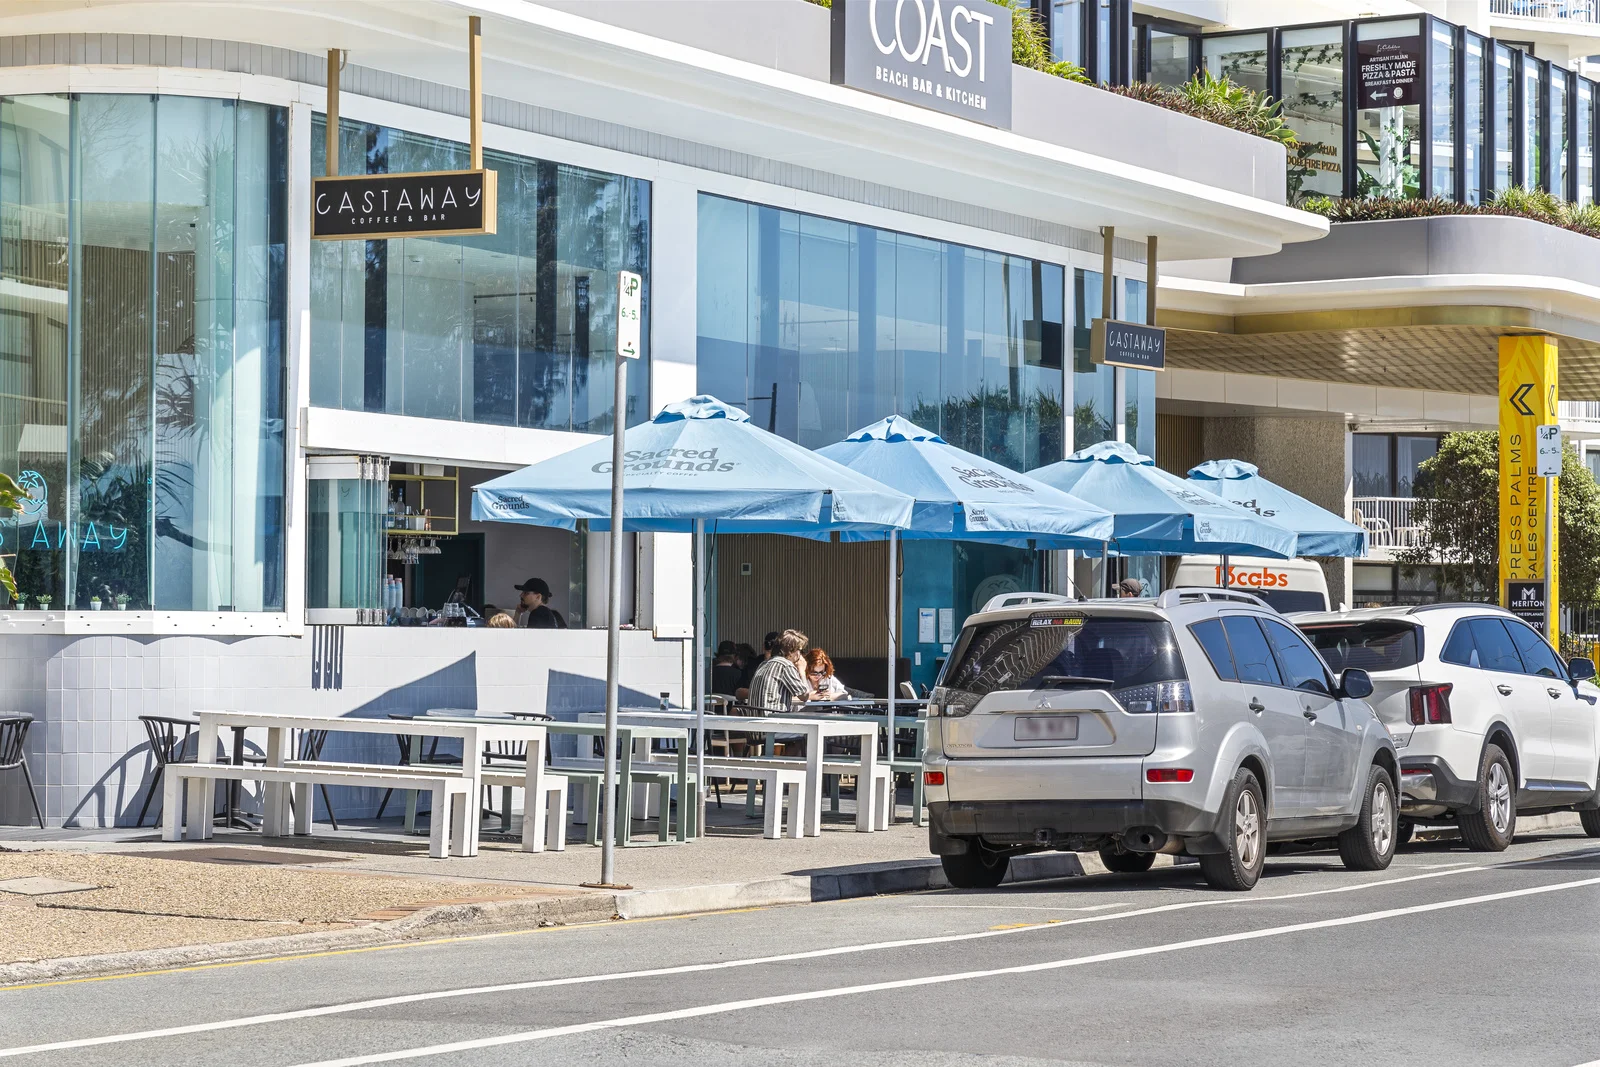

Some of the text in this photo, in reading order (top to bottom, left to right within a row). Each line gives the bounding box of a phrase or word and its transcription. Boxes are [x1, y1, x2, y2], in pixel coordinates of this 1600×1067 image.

[869, 0, 993, 82] COAST
[1361, 60, 1416, 72] FRESHLY MADE
[1362, 68, 1416, 80] PIZZA & PASTA
[875, 66, 987, 110] BEACH BAR & KITCHEN
[1365, 79, 1391, 87] BREAKFAST
[1322, 160, 1341, 173] PIZZA
[316, 186, 482, 215] CASTAWAY
[351, 212, 447, 225] COFFEE & BAR
[1109, 330, 1161, 353] CASTAWAY
[623, 447, 719, 462] Sacred
[591, 458, 735, 474] Grounds
[1510, 434, 1522, 506] PALMS
[491, 500, 530, 510] Grounds
[497, 494, 523, 503] Sacred
[1528, 466, 1538, 579] SALES CENTRE
